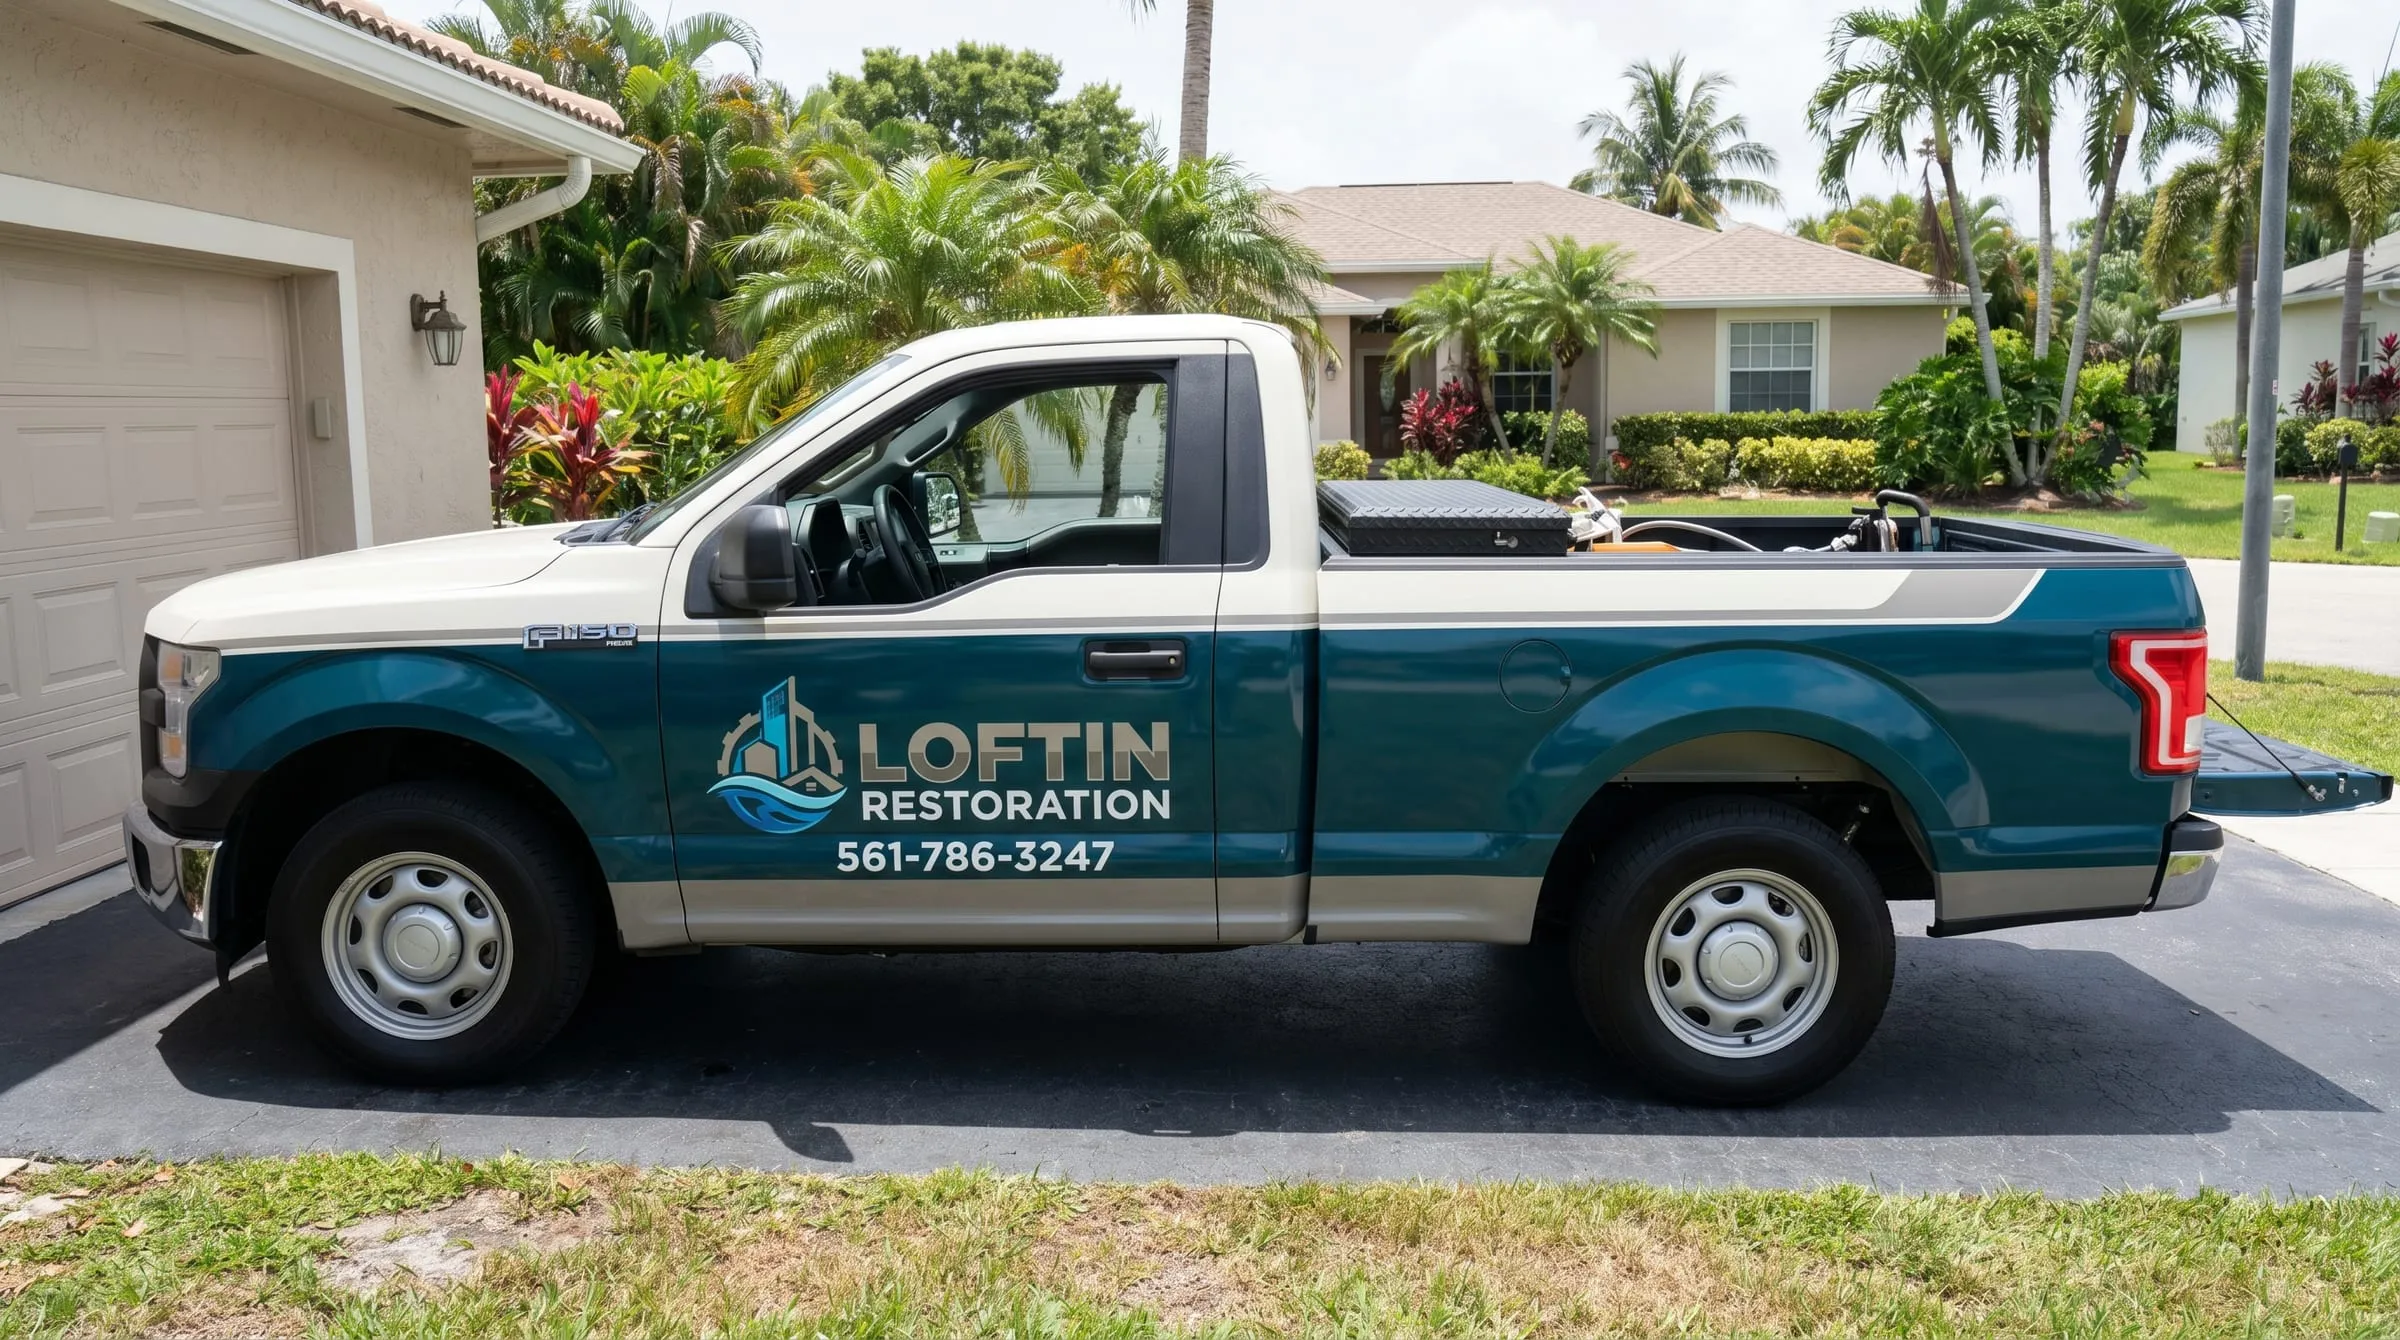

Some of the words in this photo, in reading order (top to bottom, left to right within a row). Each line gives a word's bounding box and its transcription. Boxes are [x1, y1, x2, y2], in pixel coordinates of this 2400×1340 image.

[858, 721, 1171, 784] LOFTIN
[861, 788, 1171, 821] RESTORATION
[836, 840, 1115, 873] 561-786-3247
